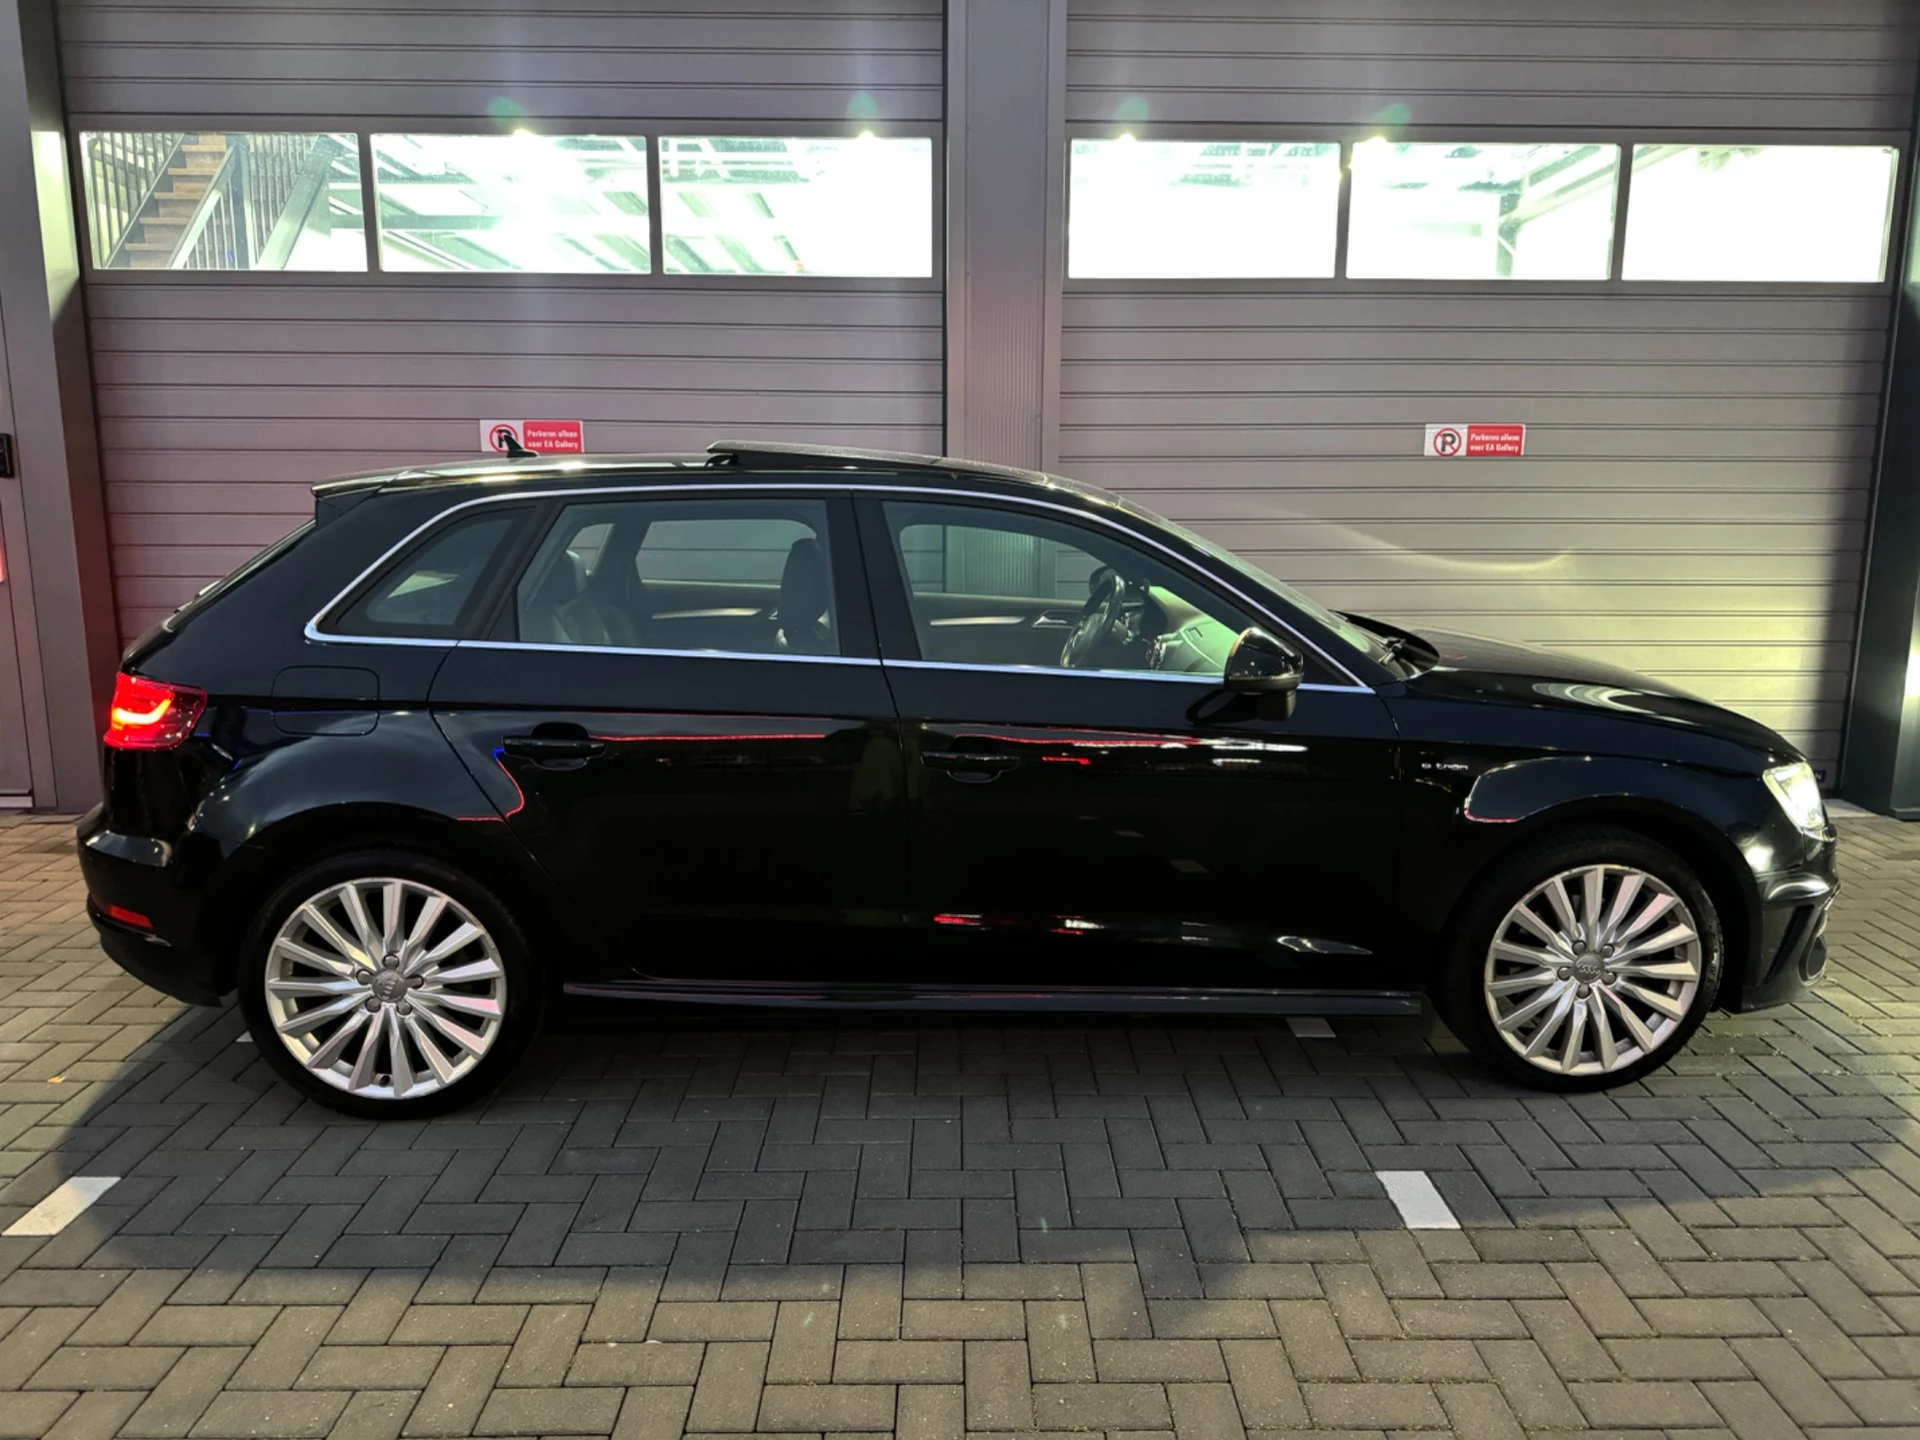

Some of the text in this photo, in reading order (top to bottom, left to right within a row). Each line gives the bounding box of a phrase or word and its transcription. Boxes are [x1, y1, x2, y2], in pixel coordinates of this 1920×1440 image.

[526, 430, 578, 439] Parkeren alleen
[1470, 433, 1520, 442] Parkeren alleen
[555, 441, 579, 450] Gallery
[1496, 444, 1519, 453] Gallery
